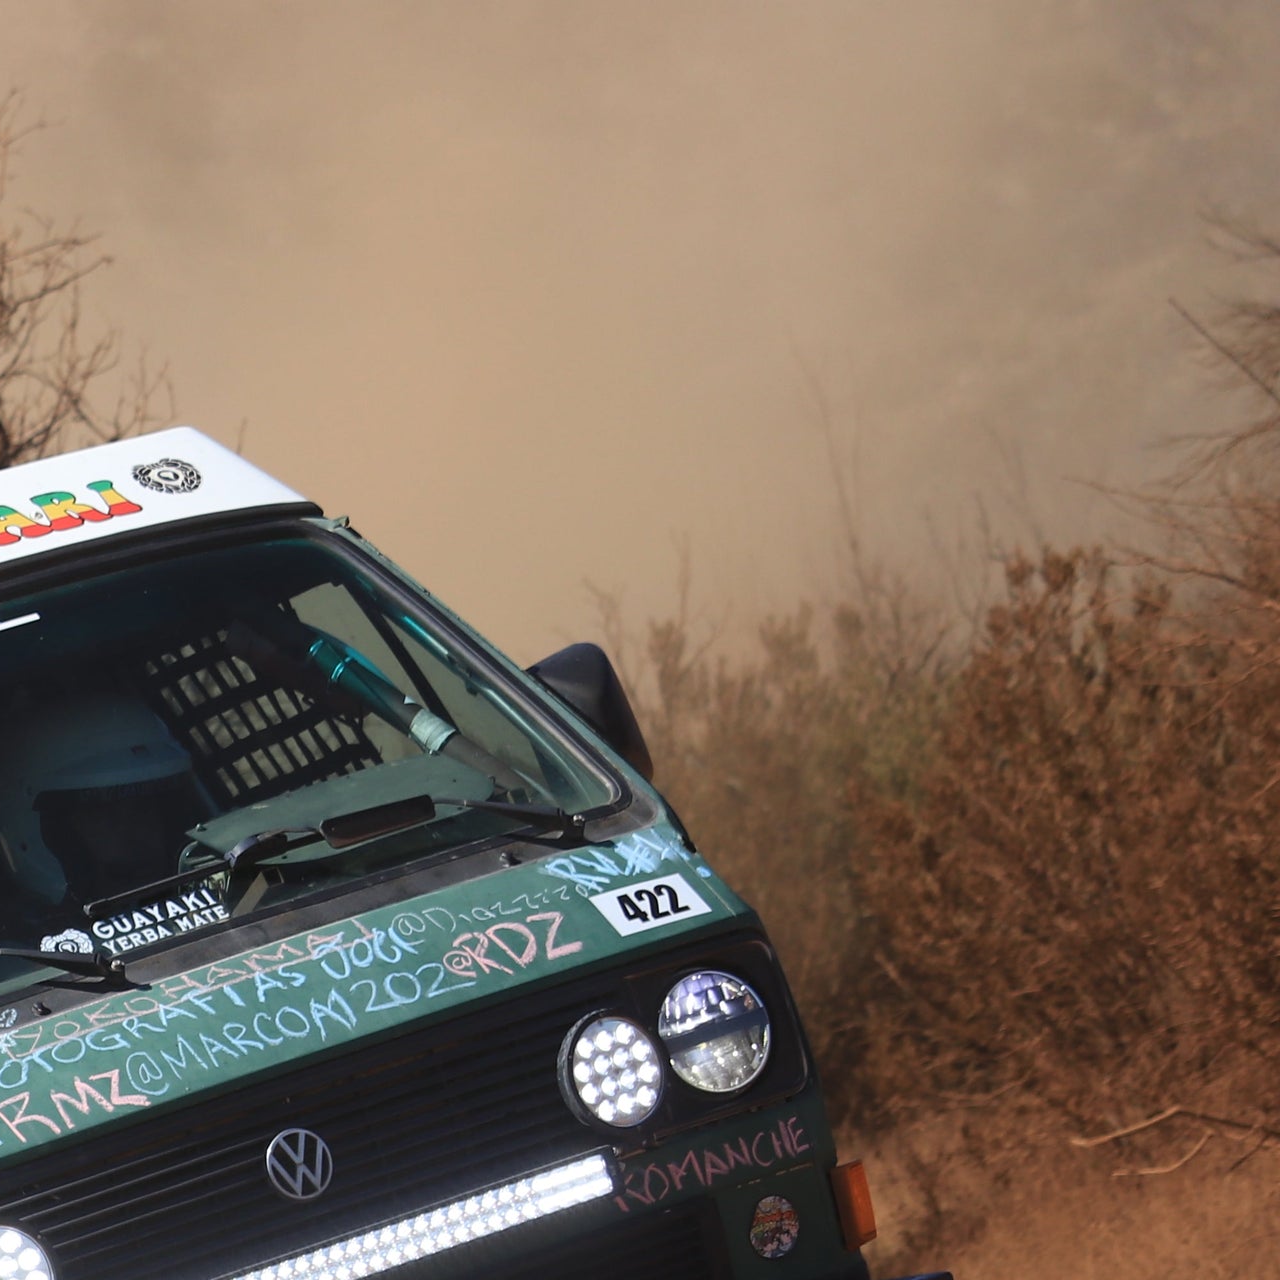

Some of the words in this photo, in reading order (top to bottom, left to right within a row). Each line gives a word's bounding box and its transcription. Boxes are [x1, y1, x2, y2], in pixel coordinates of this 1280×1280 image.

[93, 889, 217, 939] GUAYAKI
[617, 885, 690, 923] 422
[102, 925, 172, 955] YERBA
[176, 905, 230, 932] MATE
